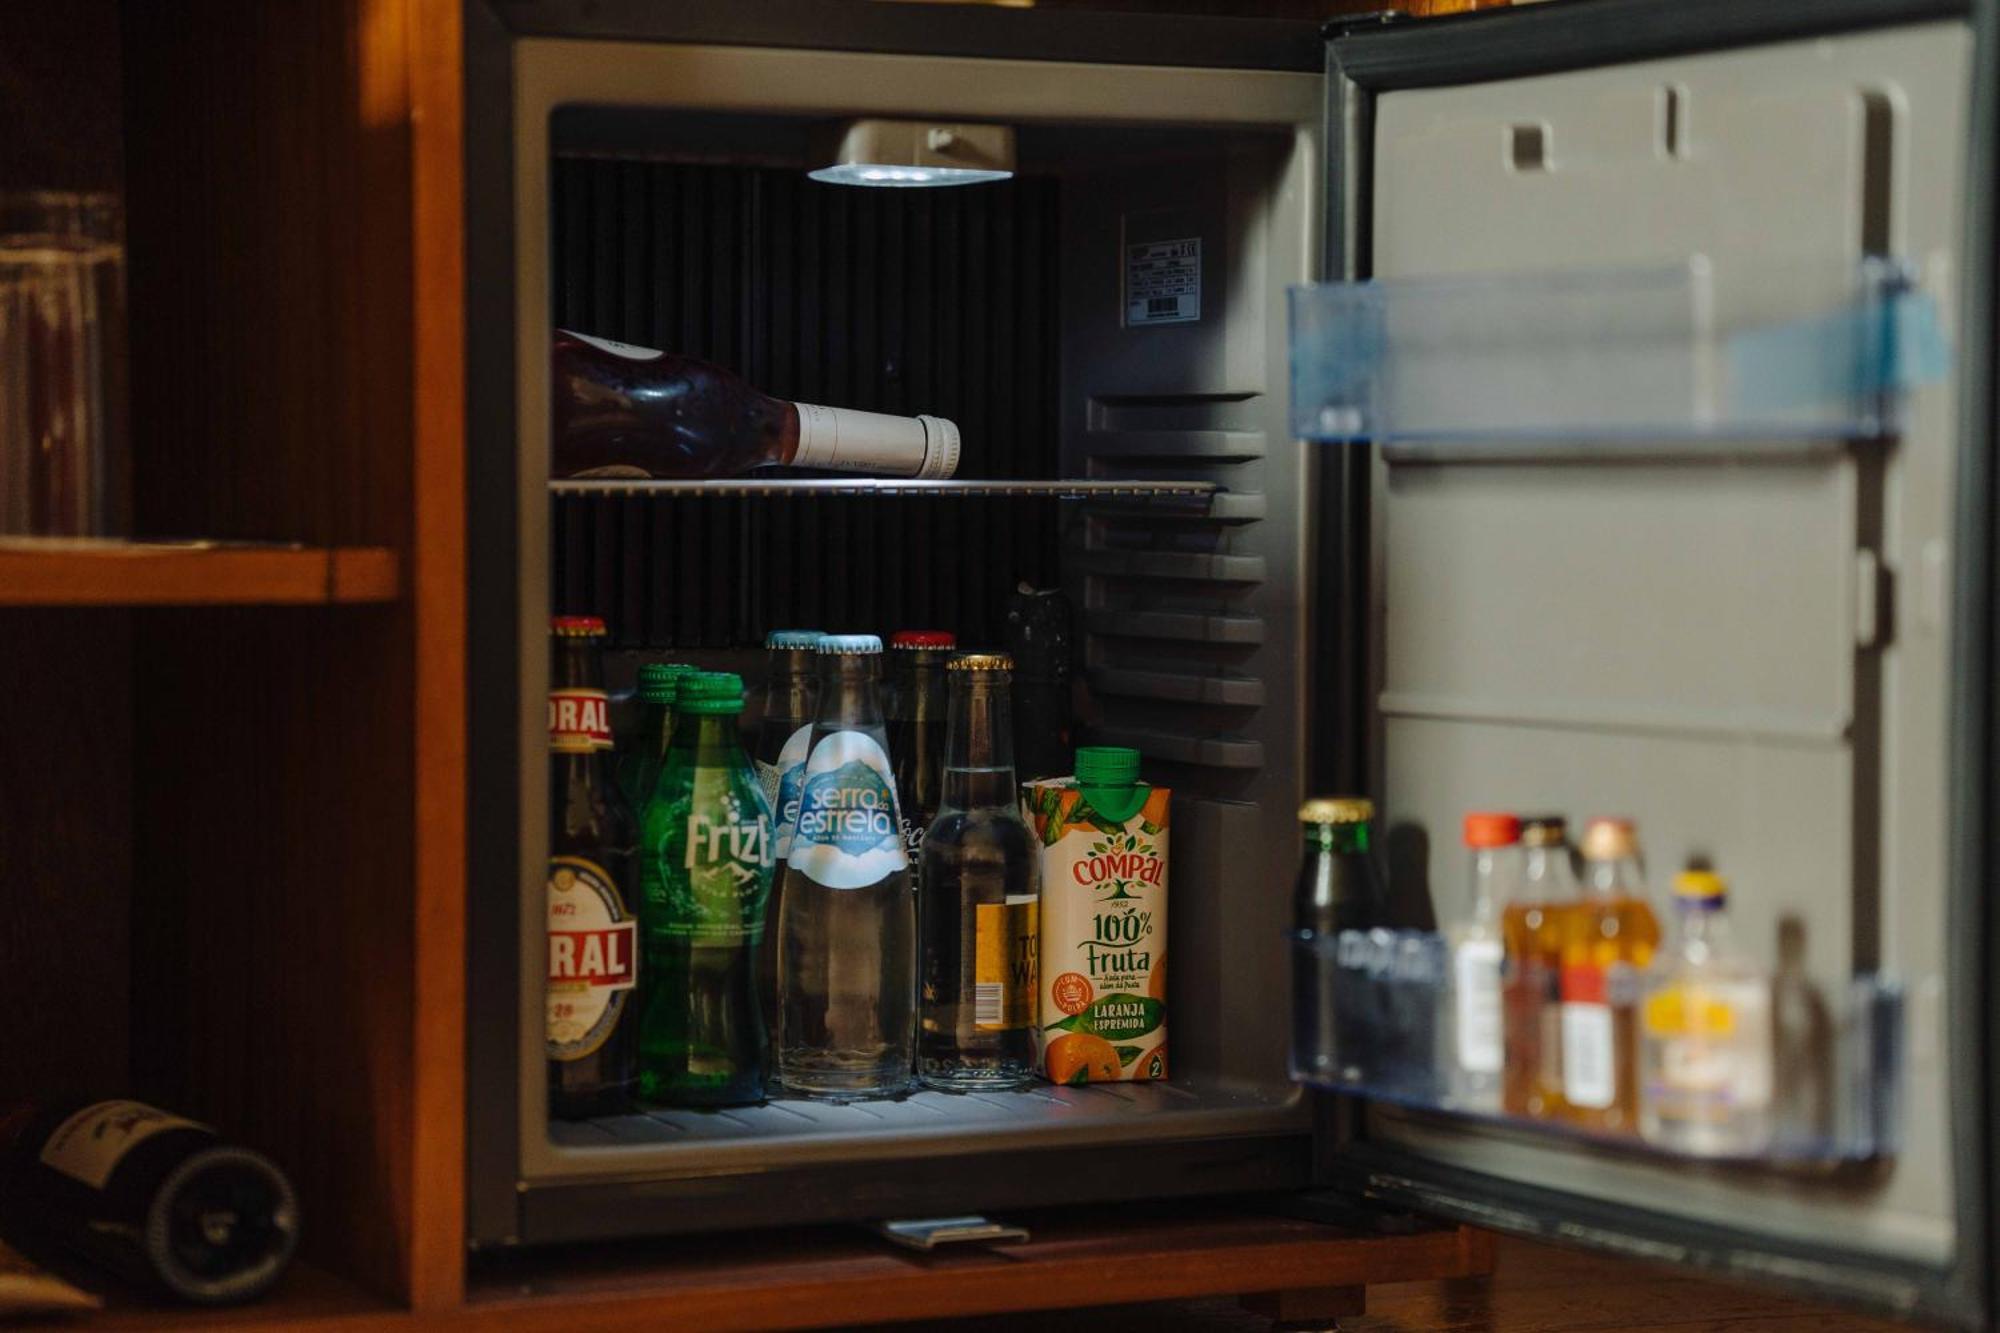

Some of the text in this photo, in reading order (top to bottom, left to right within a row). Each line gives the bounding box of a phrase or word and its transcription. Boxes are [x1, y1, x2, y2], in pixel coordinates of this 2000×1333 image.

[811, 788, 878, 809] serra
[800, 809, 891, 834] estrela
[1093, 911, 1153, 941] 100%
[1094, 1003, 1145, 1018] LARANJA
[1094, 1018, 1145, 1031] ESPREMIDA
[1151, 1061, 1160, 1077] 2
